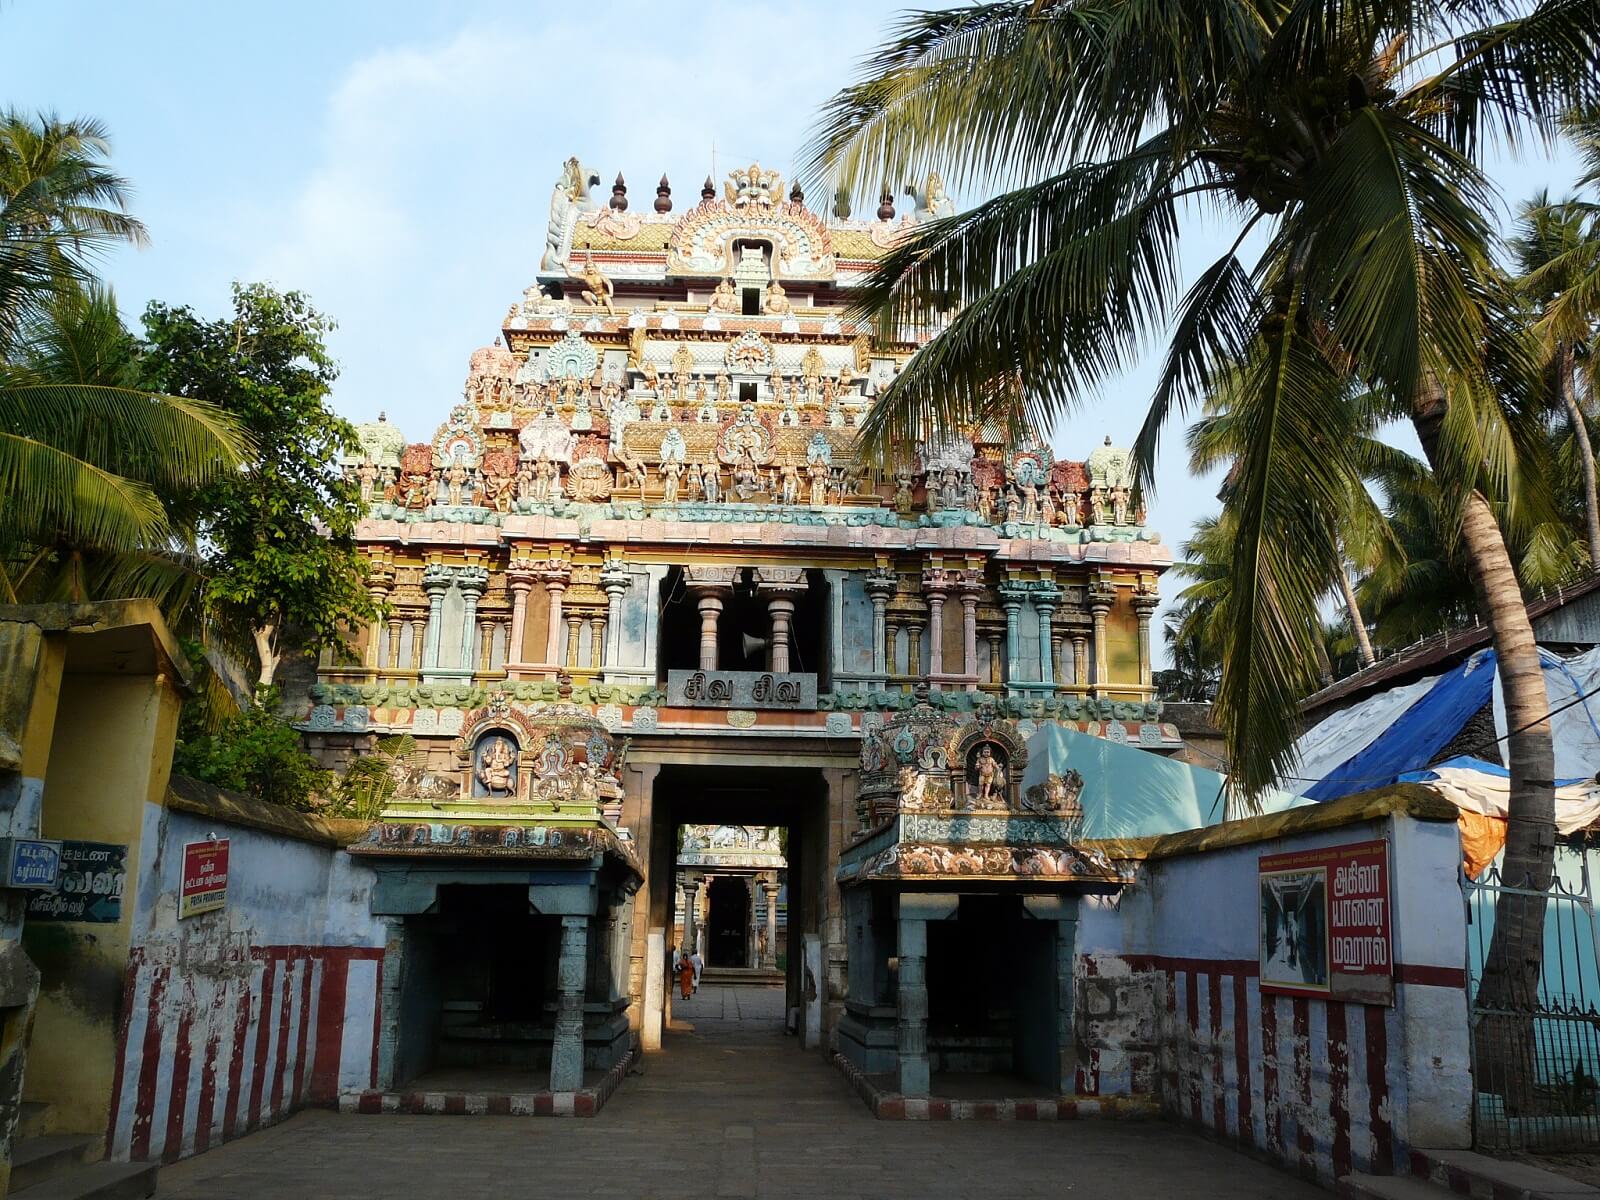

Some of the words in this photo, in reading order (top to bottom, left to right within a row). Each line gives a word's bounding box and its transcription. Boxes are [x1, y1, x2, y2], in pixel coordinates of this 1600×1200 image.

[684, 672, 734, 701] சிவ
[751, 674, 801, 702] சிவ
[1333, 860, 1380, 897] அகிலா
[1332, 897, 1384, 927] யானை
[1332, 926, 1387, 971] மஹால்
